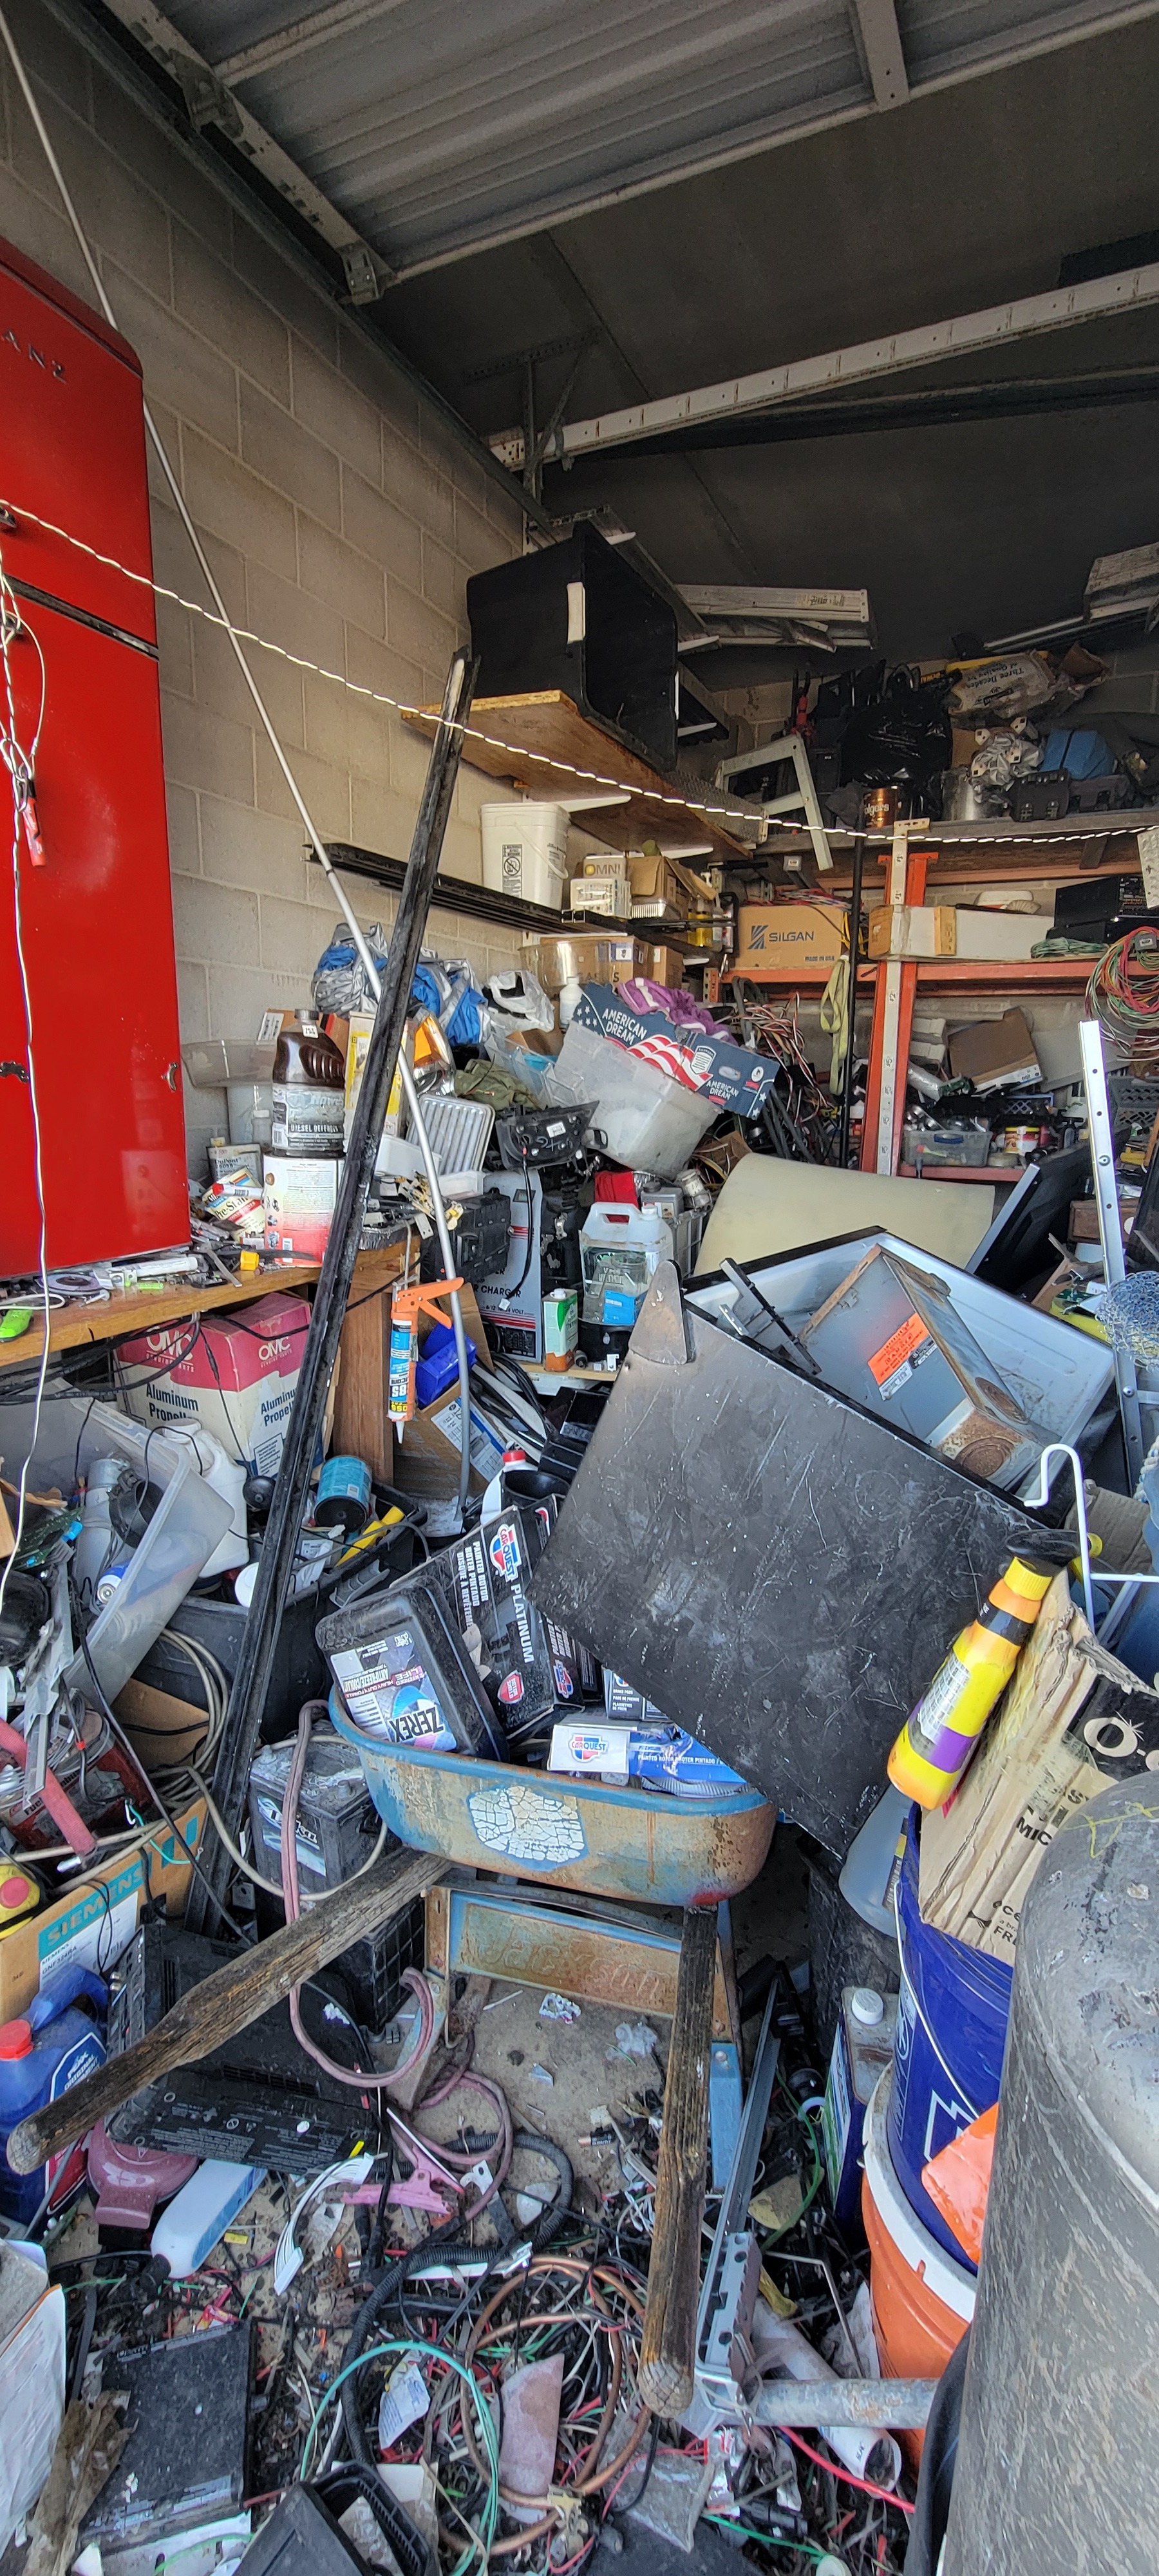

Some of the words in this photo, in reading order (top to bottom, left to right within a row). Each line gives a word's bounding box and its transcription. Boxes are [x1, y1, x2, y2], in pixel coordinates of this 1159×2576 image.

[864, 803, 890, 817] olgers
[768, 931, 815, 942] SILGAN
[601, 1008, 648, 1040] AMERICAN
[605, 1021, 635, 1046] DREAM
[706, 1079, 740, 1097] AMERICAN
[710, 1087, 731, 1101] DREAM
[480, 1285, 522, 1298] CHARGR
[146, 1325, 194, 1361] OMC
[258, 1336, 291, 1361] OMC
[146, 1383, 199, 1412] Aluminum
[261, 1387, 297, 1416] Aluminu
[149, 1402, 187, 1422] Propell
[457, 1551, 467, 1580] DISQUE
[473, 1540, 485, 1574] PAINTED
[500, 1528, 515, 1578] CARQUEST
[468, 1571, 480, 1607] PINTADO
[478, 1574, 489, 1602] ROTOR
[511, 1584, 535, 1663] PLATINUM
[378, 1681, 394, 1689] HEAVY
[395, 1667, 421, 1680] LIFE
[389, 1705, 444, 1743] ZEREX
[571, 1741, 607, 1751] CARQUEST
[48, 1866, 143, 1946] SIEMENS
